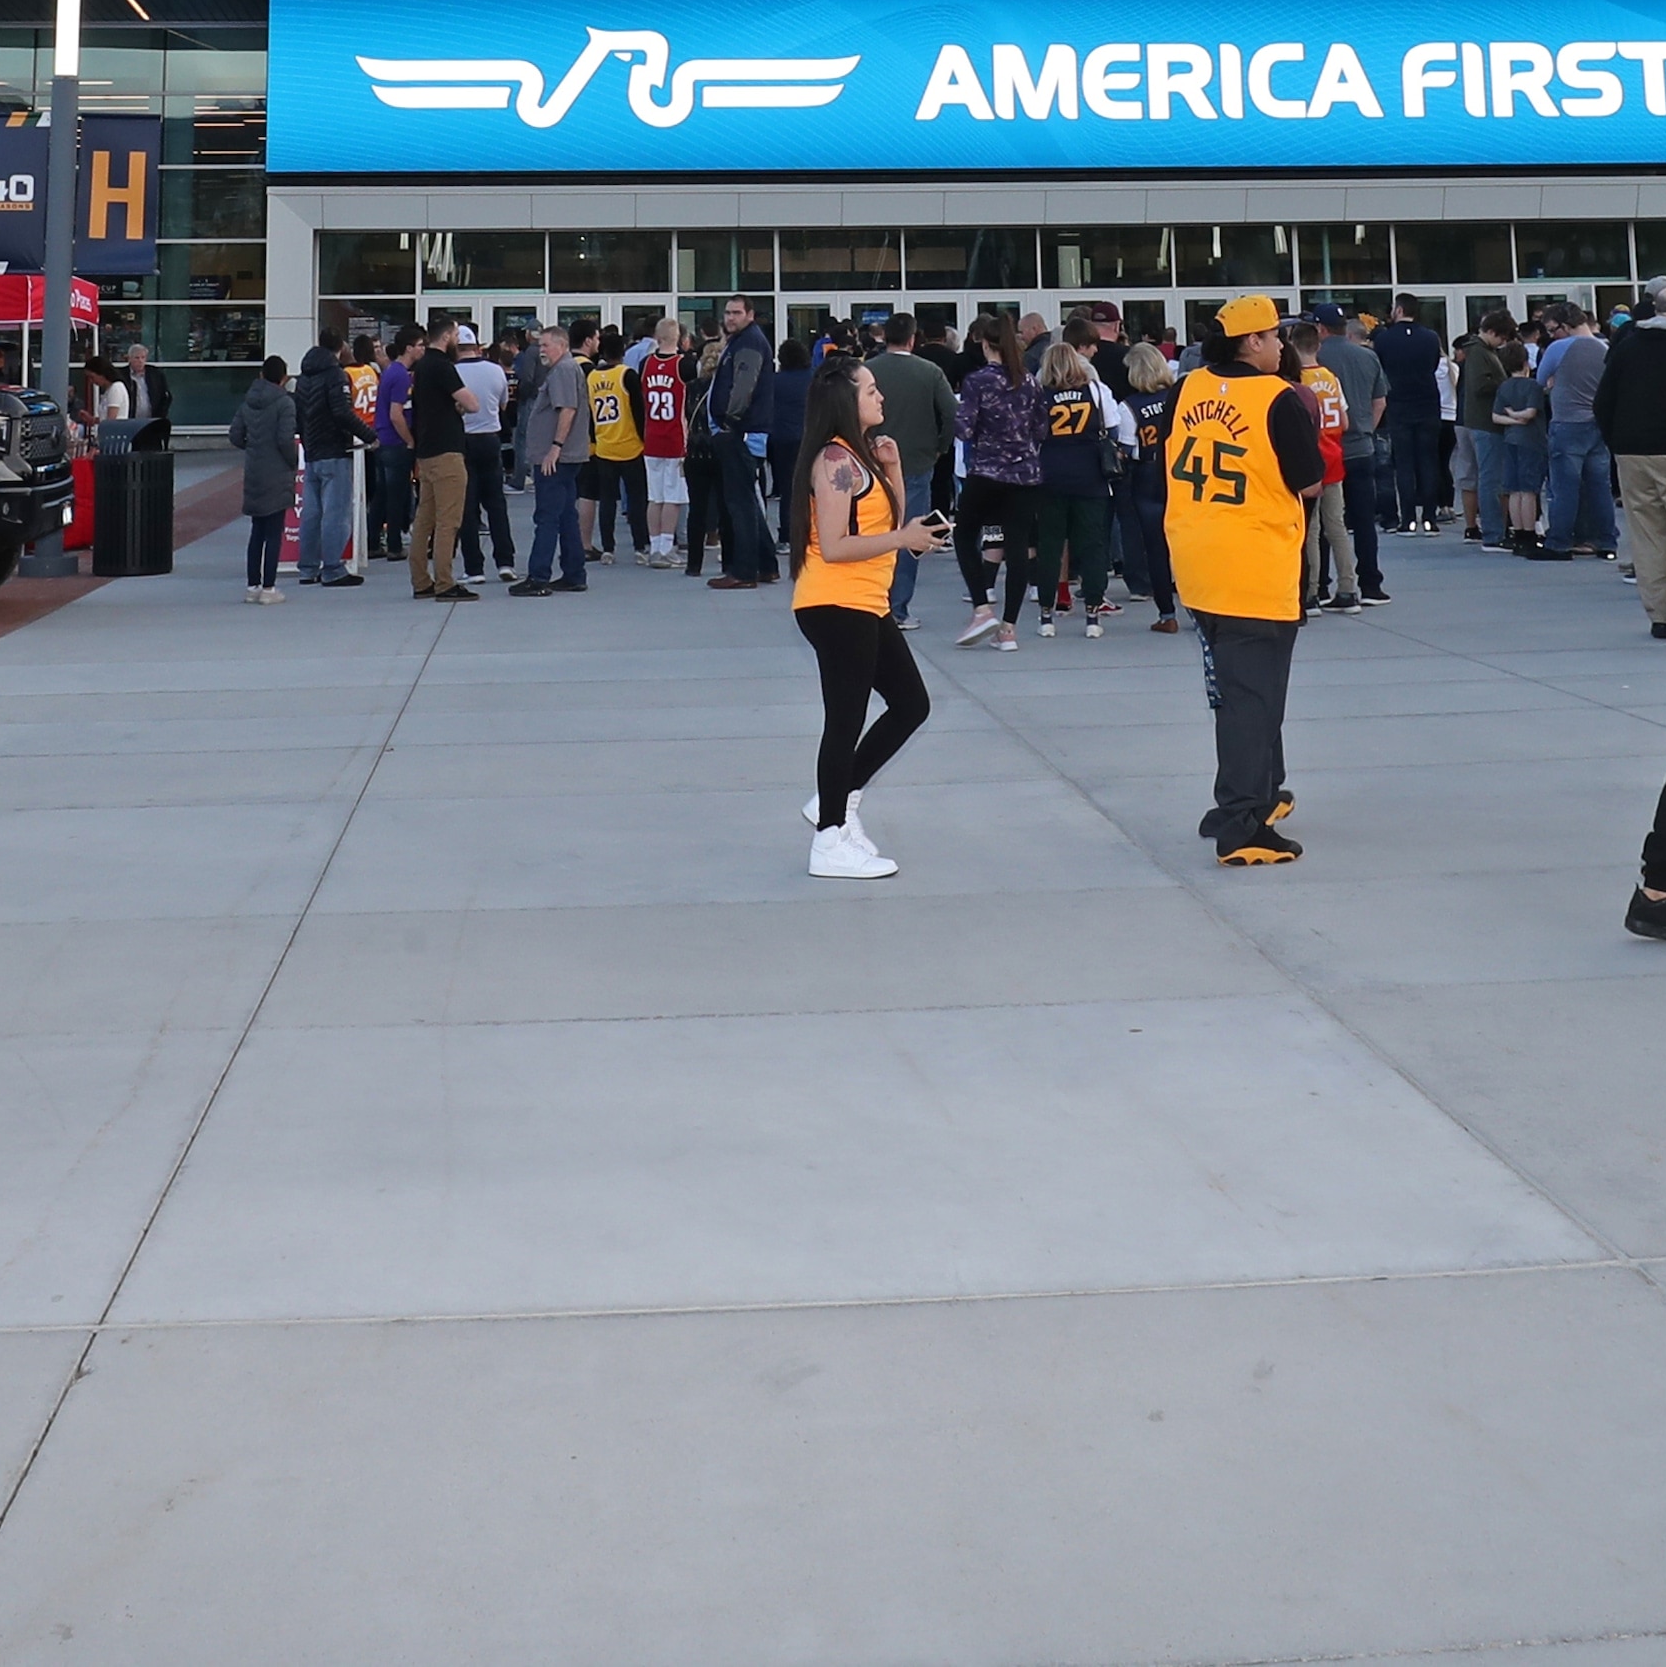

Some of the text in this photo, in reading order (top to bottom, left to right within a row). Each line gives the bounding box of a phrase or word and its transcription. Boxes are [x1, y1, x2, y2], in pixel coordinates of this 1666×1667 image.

[914, 42, 1386, 121] AMERICA
[88, 150, 147, 240] H
[646, 374, 674, 388] JAMES
[593, 394, 621, 424] 23
[647, 390, 675, 421] 23
[1049, 401, 1091, 436] 27
[1181, 399, 1250, 442] MITCHELL
[1170, 435, 1249, 506] 45
